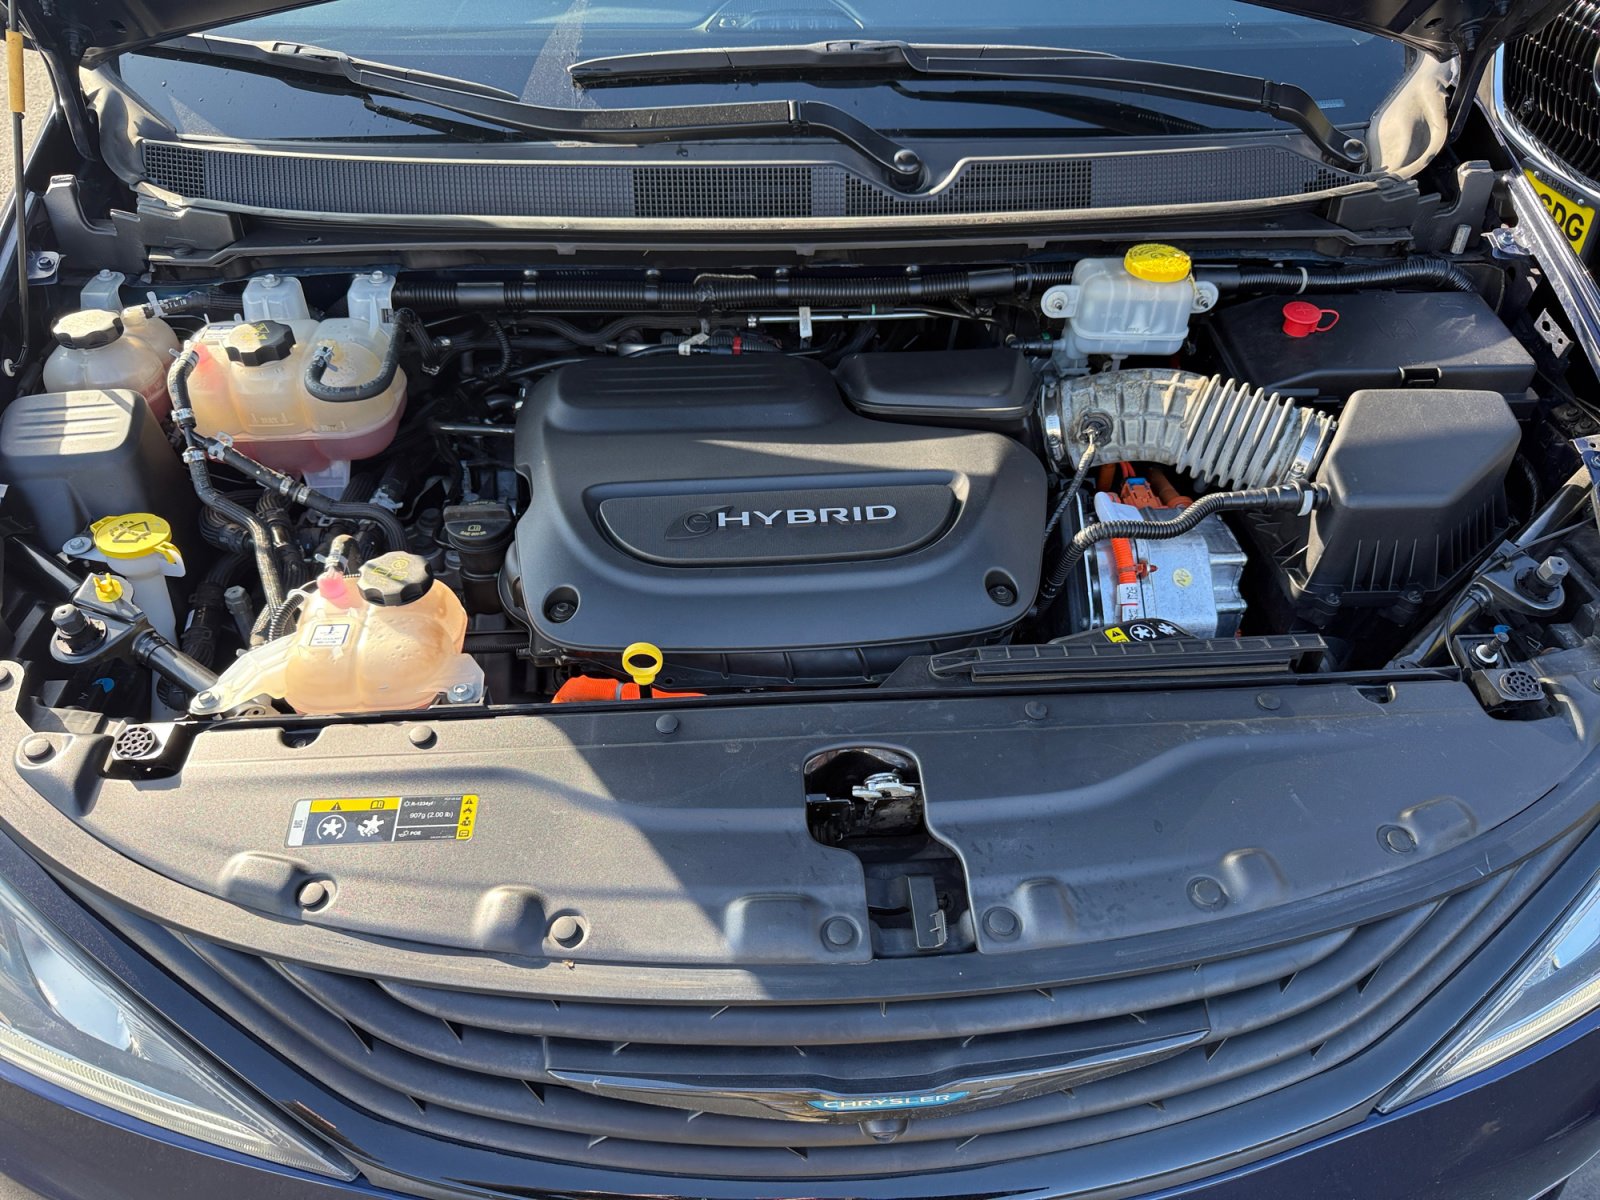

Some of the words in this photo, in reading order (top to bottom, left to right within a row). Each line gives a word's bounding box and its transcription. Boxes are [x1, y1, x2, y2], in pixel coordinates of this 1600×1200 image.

[409, 812, 426, 820] 907g
[427, 811, 444, 819] (2.00
[444, 811, 455, 819] lb)
[824, 1094, 950, 1109] CHRYSLER
